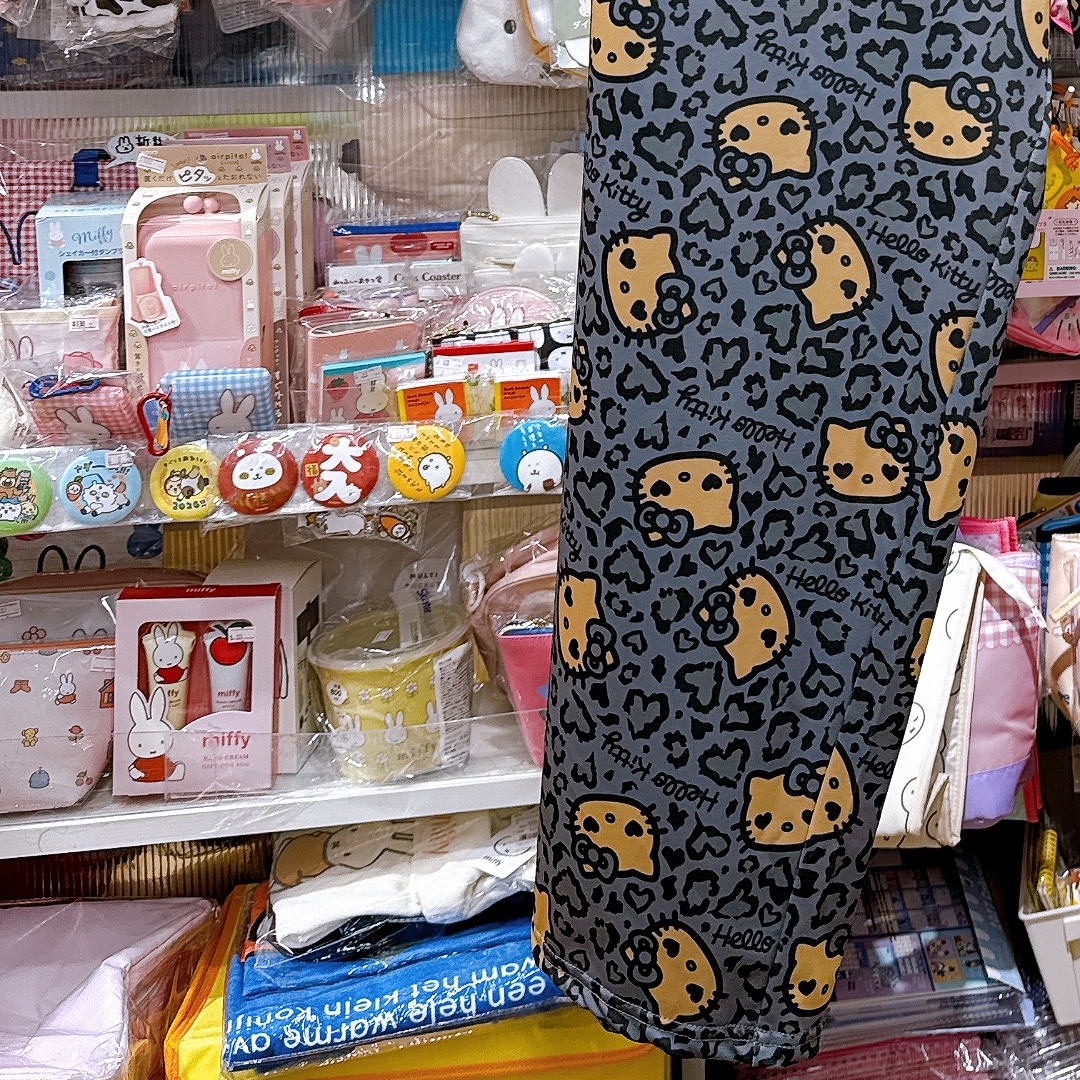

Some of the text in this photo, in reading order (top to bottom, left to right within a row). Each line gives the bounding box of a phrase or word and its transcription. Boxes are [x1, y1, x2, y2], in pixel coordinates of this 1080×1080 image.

[753, 28, 878, 107] Hello Kitty
[600, 176, 653, 220] Kitty
[71, 225, 113, 245] Miffy
[422, 271, 462, 283] Coaster
[868, 224, 981, 304] Hello Kitty
[676, 383, 798, 453] Hello Kitty
[784, 564, 892, 634] Hello Kitt
[217, 689, 241, 698] miffy
[202, 730, 251, 749] miffy
[601, 729, 721, 814] Hello Kitty
[857, 750, 895, 781] Hel
[482, 855, 502, 867] miffy
[711, 923, 779, 954] Hello
[324, 989, 399, 1017] klein
[410, 976, 459, 1001] het
[488, 975, 547, 1008] een
[409, 992, 477, 1024] hele
[284, 1011, 399, 1050] warme
